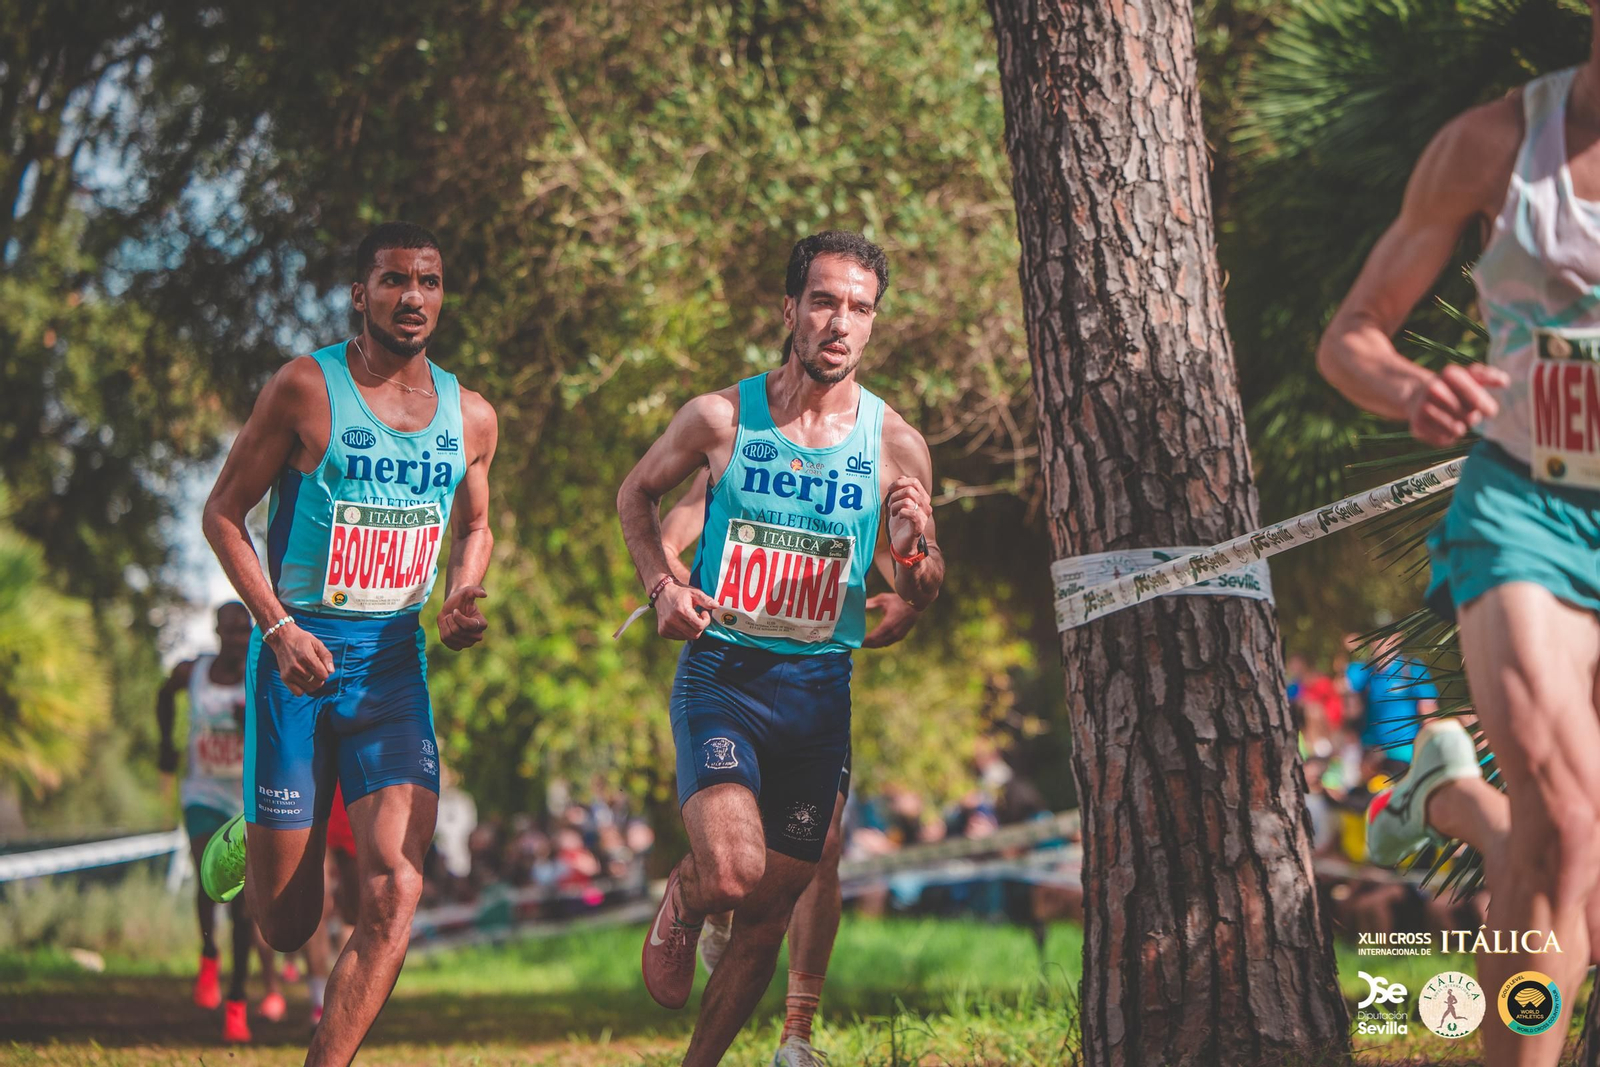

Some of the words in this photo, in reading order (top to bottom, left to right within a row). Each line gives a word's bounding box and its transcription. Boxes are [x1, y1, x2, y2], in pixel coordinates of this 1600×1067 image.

[343, 430, 376, 447] TROPS
[436, 429, 459, 451] als
[743, 443, 778, 460] TROPS
[344, 450, 452, 495] nerja
[846, 452, 873, 475] als
[741, 466, 863, 515] nerja
[1410, 471, 1441, 494] Sevilla
[369, 510, 419, 525] ITÁLICA
[1335, 500, 1364, 521] Sevilla
[756, 509, 844, 535] ATLETISMO
[763, 531, 820, 551] ITÁLICA
[1266, 525, 1294, 546] Sevilla
[328, 526, 440, 589] BOUFALJAT
[718, 545, 841, 621] AOUINA
[259, 785, 300, 801] nerja
